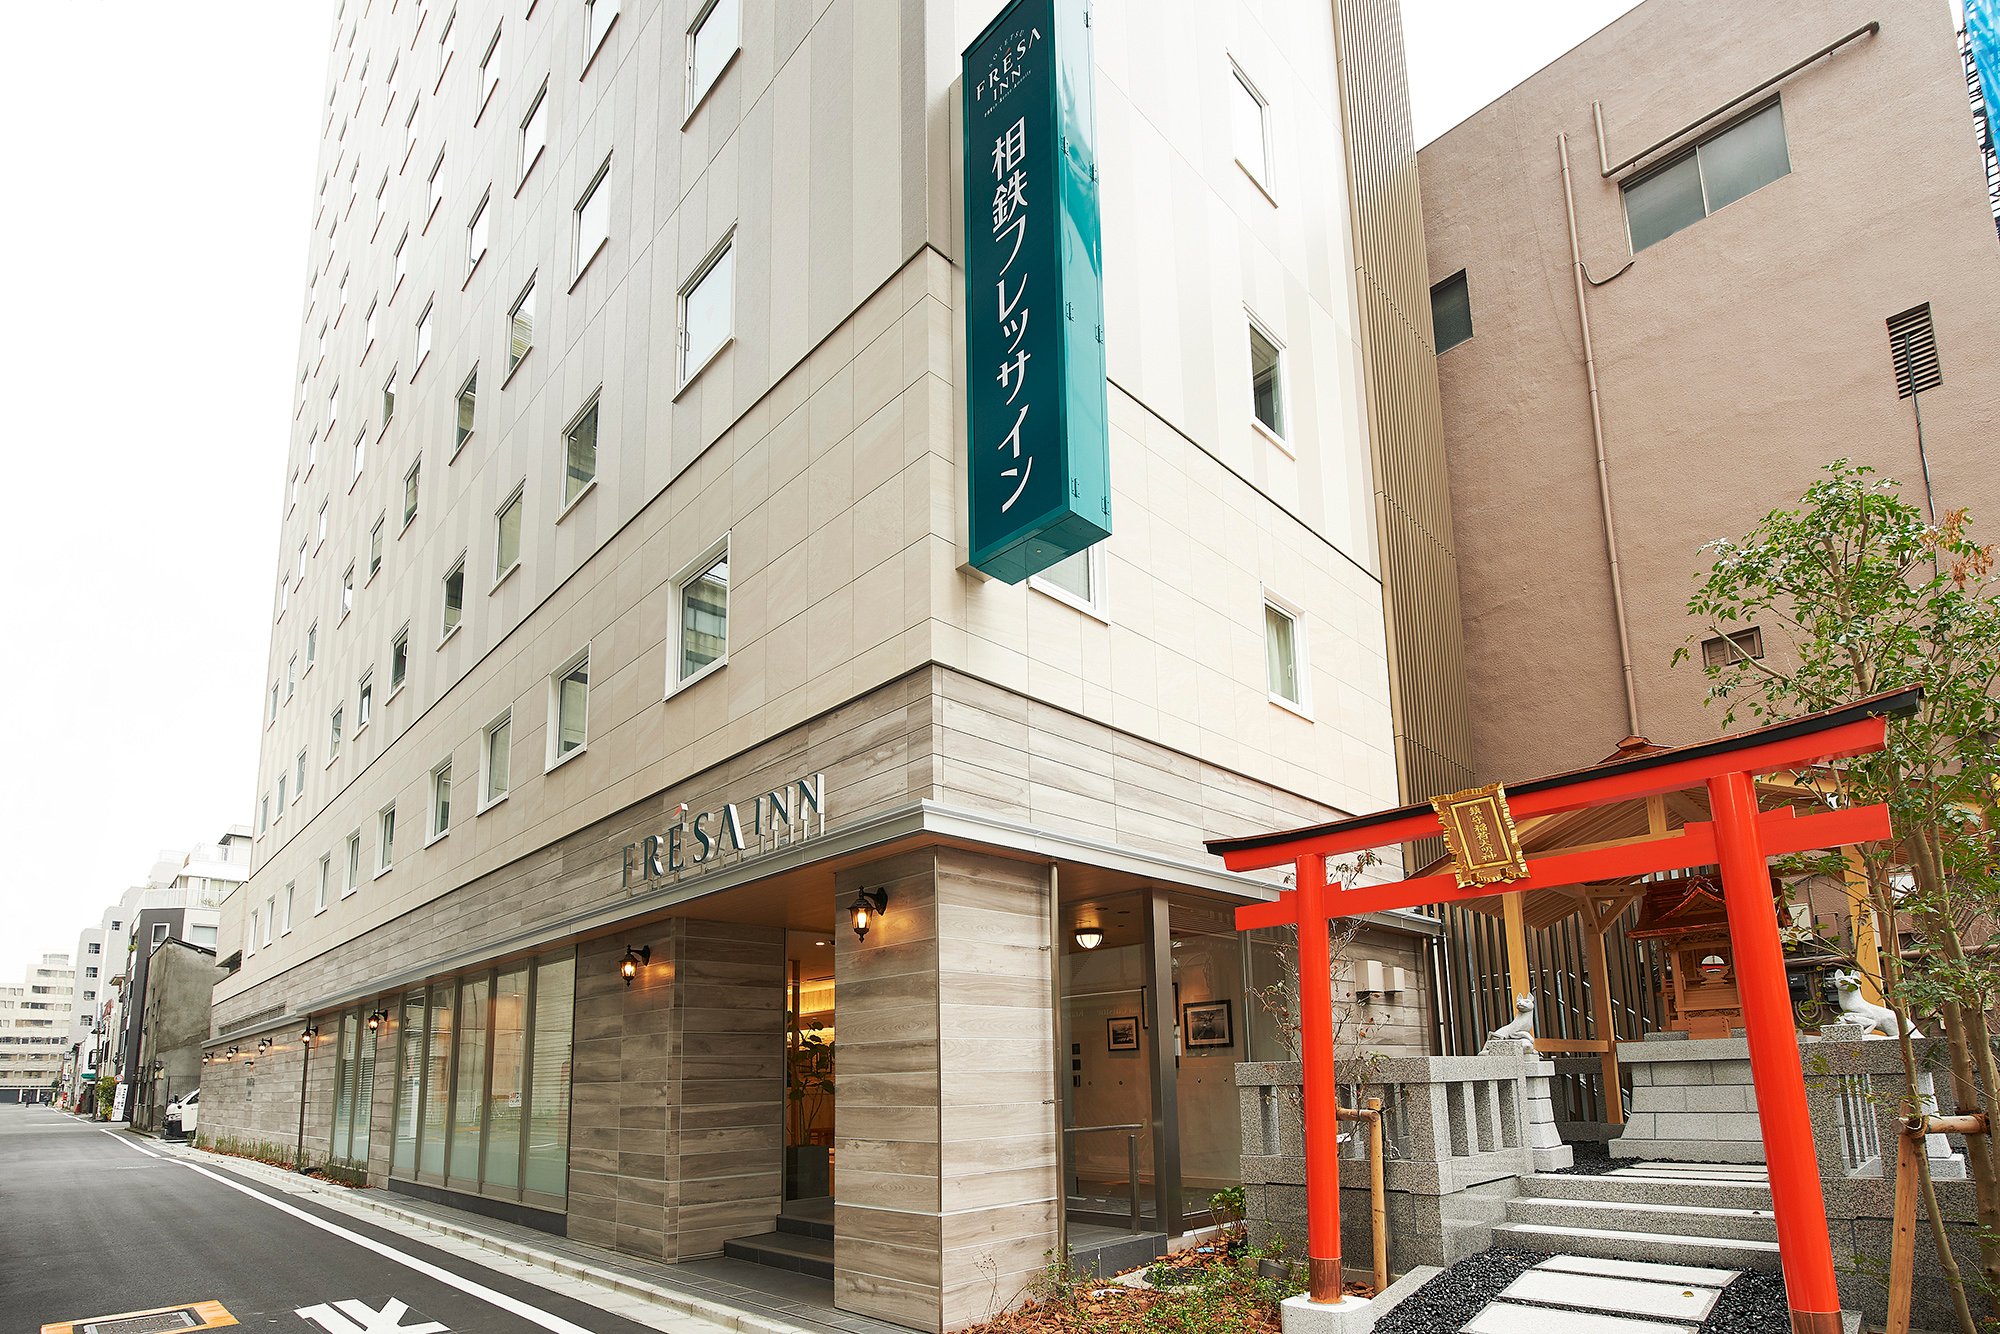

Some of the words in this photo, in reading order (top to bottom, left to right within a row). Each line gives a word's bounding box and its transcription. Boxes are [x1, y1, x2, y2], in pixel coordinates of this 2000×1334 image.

[976, 27, 1041, 102] FRÉSA
[993, 64, 1022, 101] INN
[991, 115, 1033, 514] 相鉄フレッサイン
[622, 802, 746, 889] FRÉSA
[755, 773, 825, 837] INN
